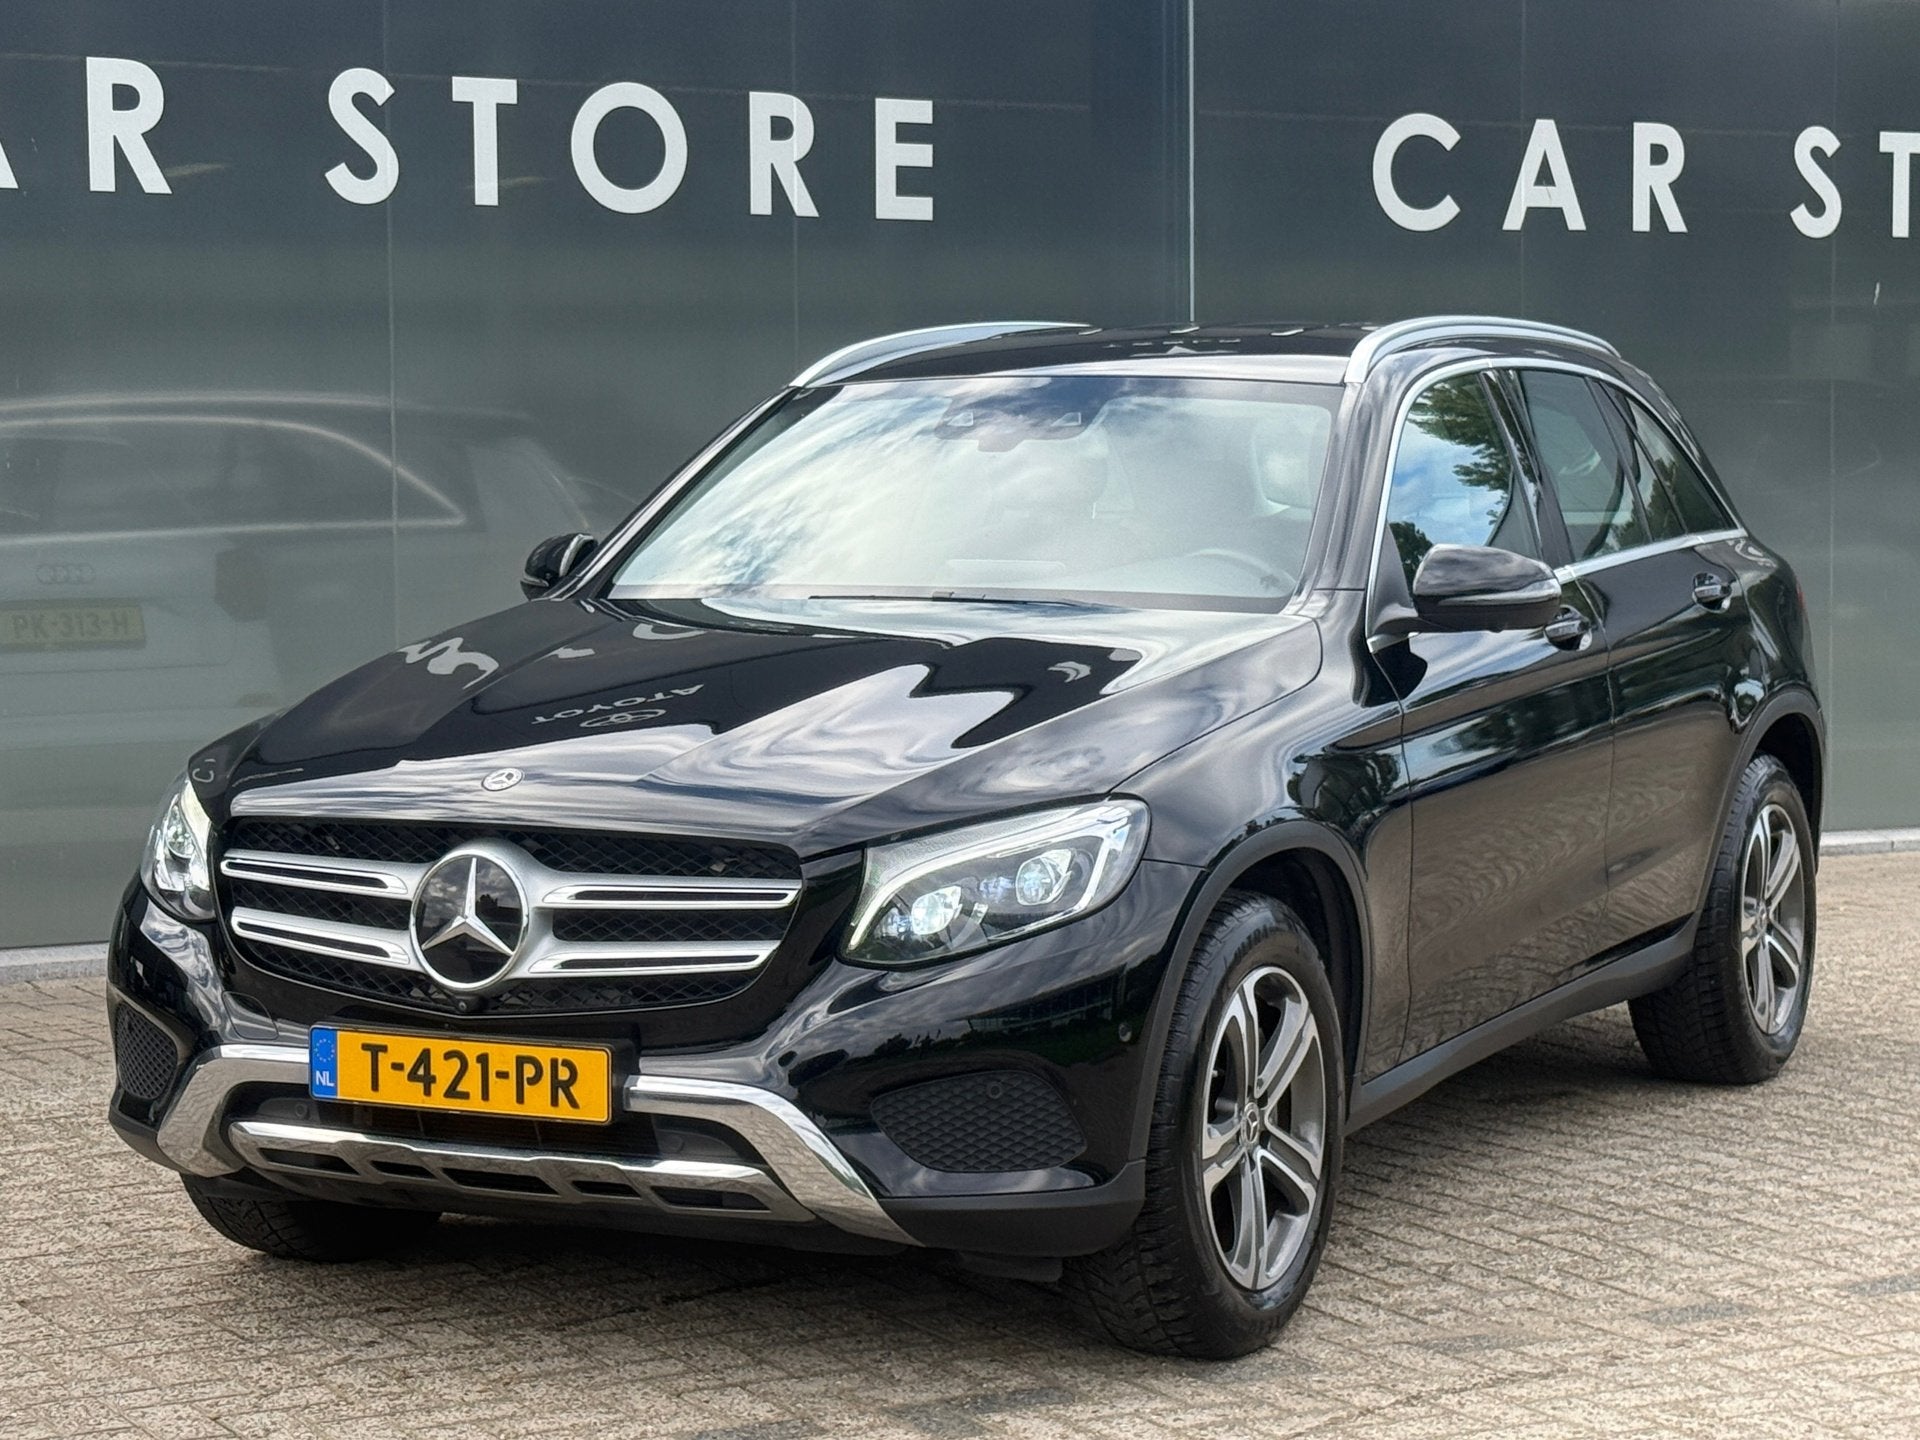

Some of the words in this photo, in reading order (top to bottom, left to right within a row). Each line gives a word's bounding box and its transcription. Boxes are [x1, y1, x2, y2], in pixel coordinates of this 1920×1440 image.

[0, 56, 173, 195] R
[325, 67, 934, 221] STORE
[1372, 112, 1688, 233] CAR
[1790, 125, 1920, 239] ST
[11, 610, 129, 639] PK-313-H
[315, 1070, 335, 1087] NL
[361, 1043, 580, 1109] T-421-PR
